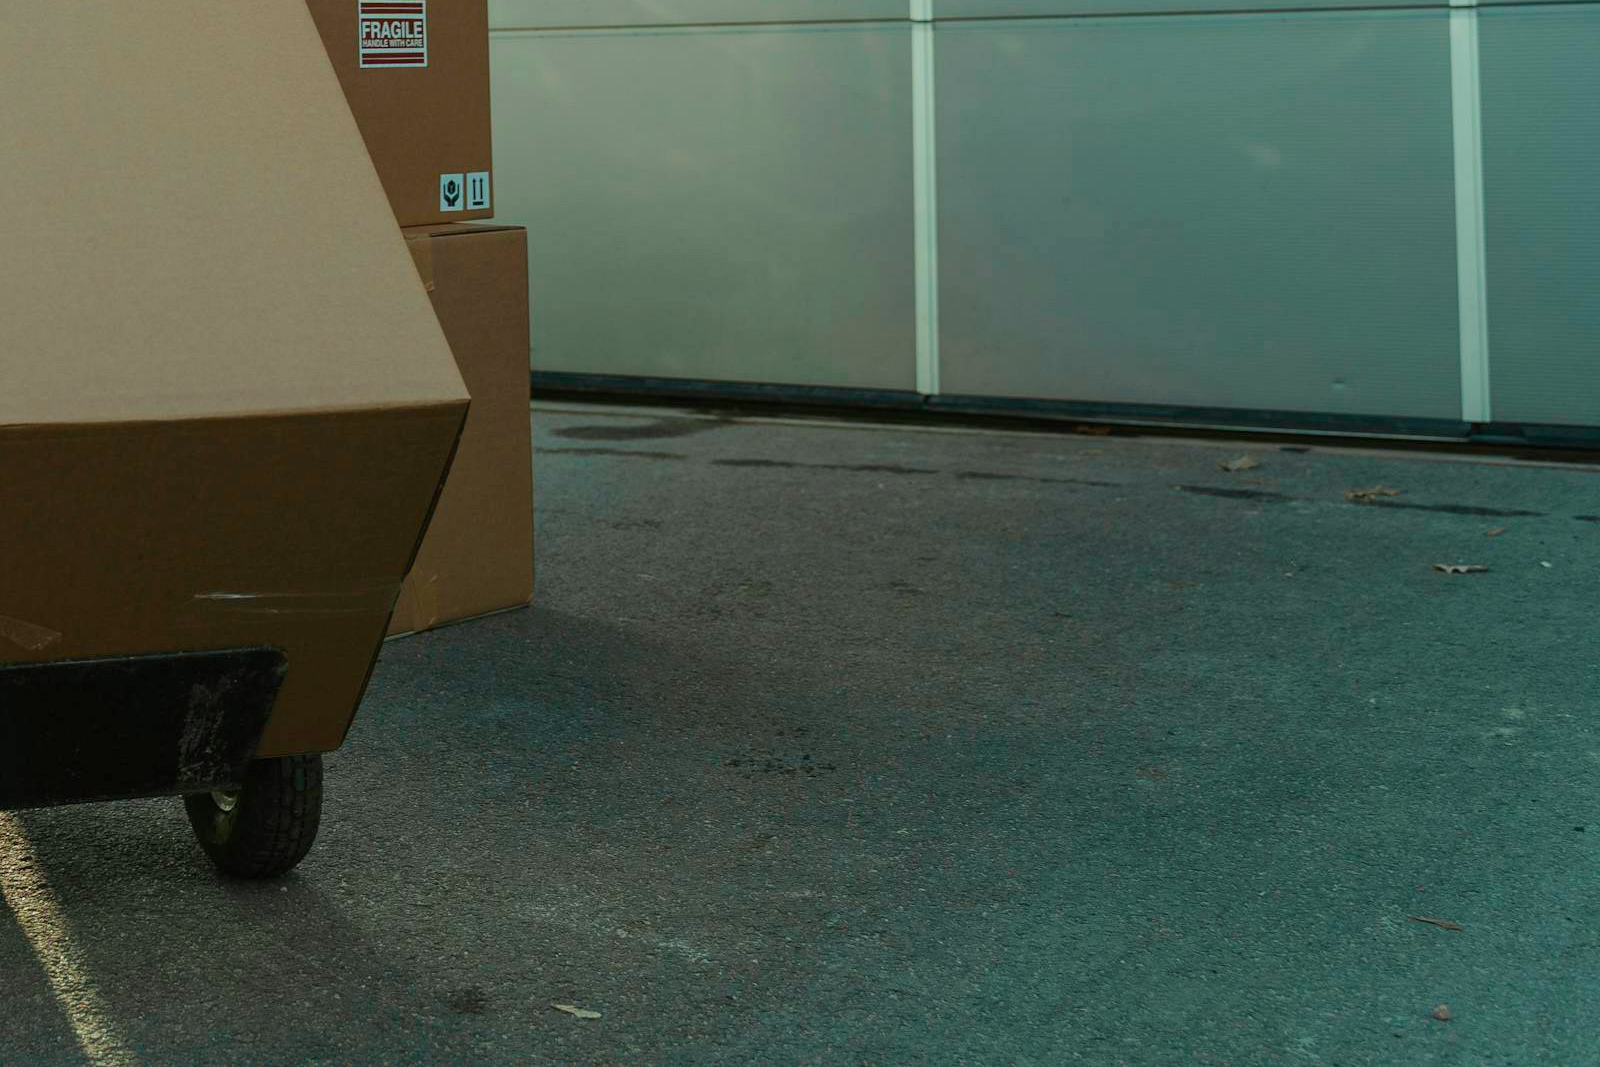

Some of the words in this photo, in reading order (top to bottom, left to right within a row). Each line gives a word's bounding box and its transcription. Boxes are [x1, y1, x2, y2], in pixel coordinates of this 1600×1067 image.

[361, 20, 424, 39] FRAGILE
[362, 39, 389, 48] HANDLE
[389, 38, 406, 47] WITH
[405, 38, 424, 47] CARE
